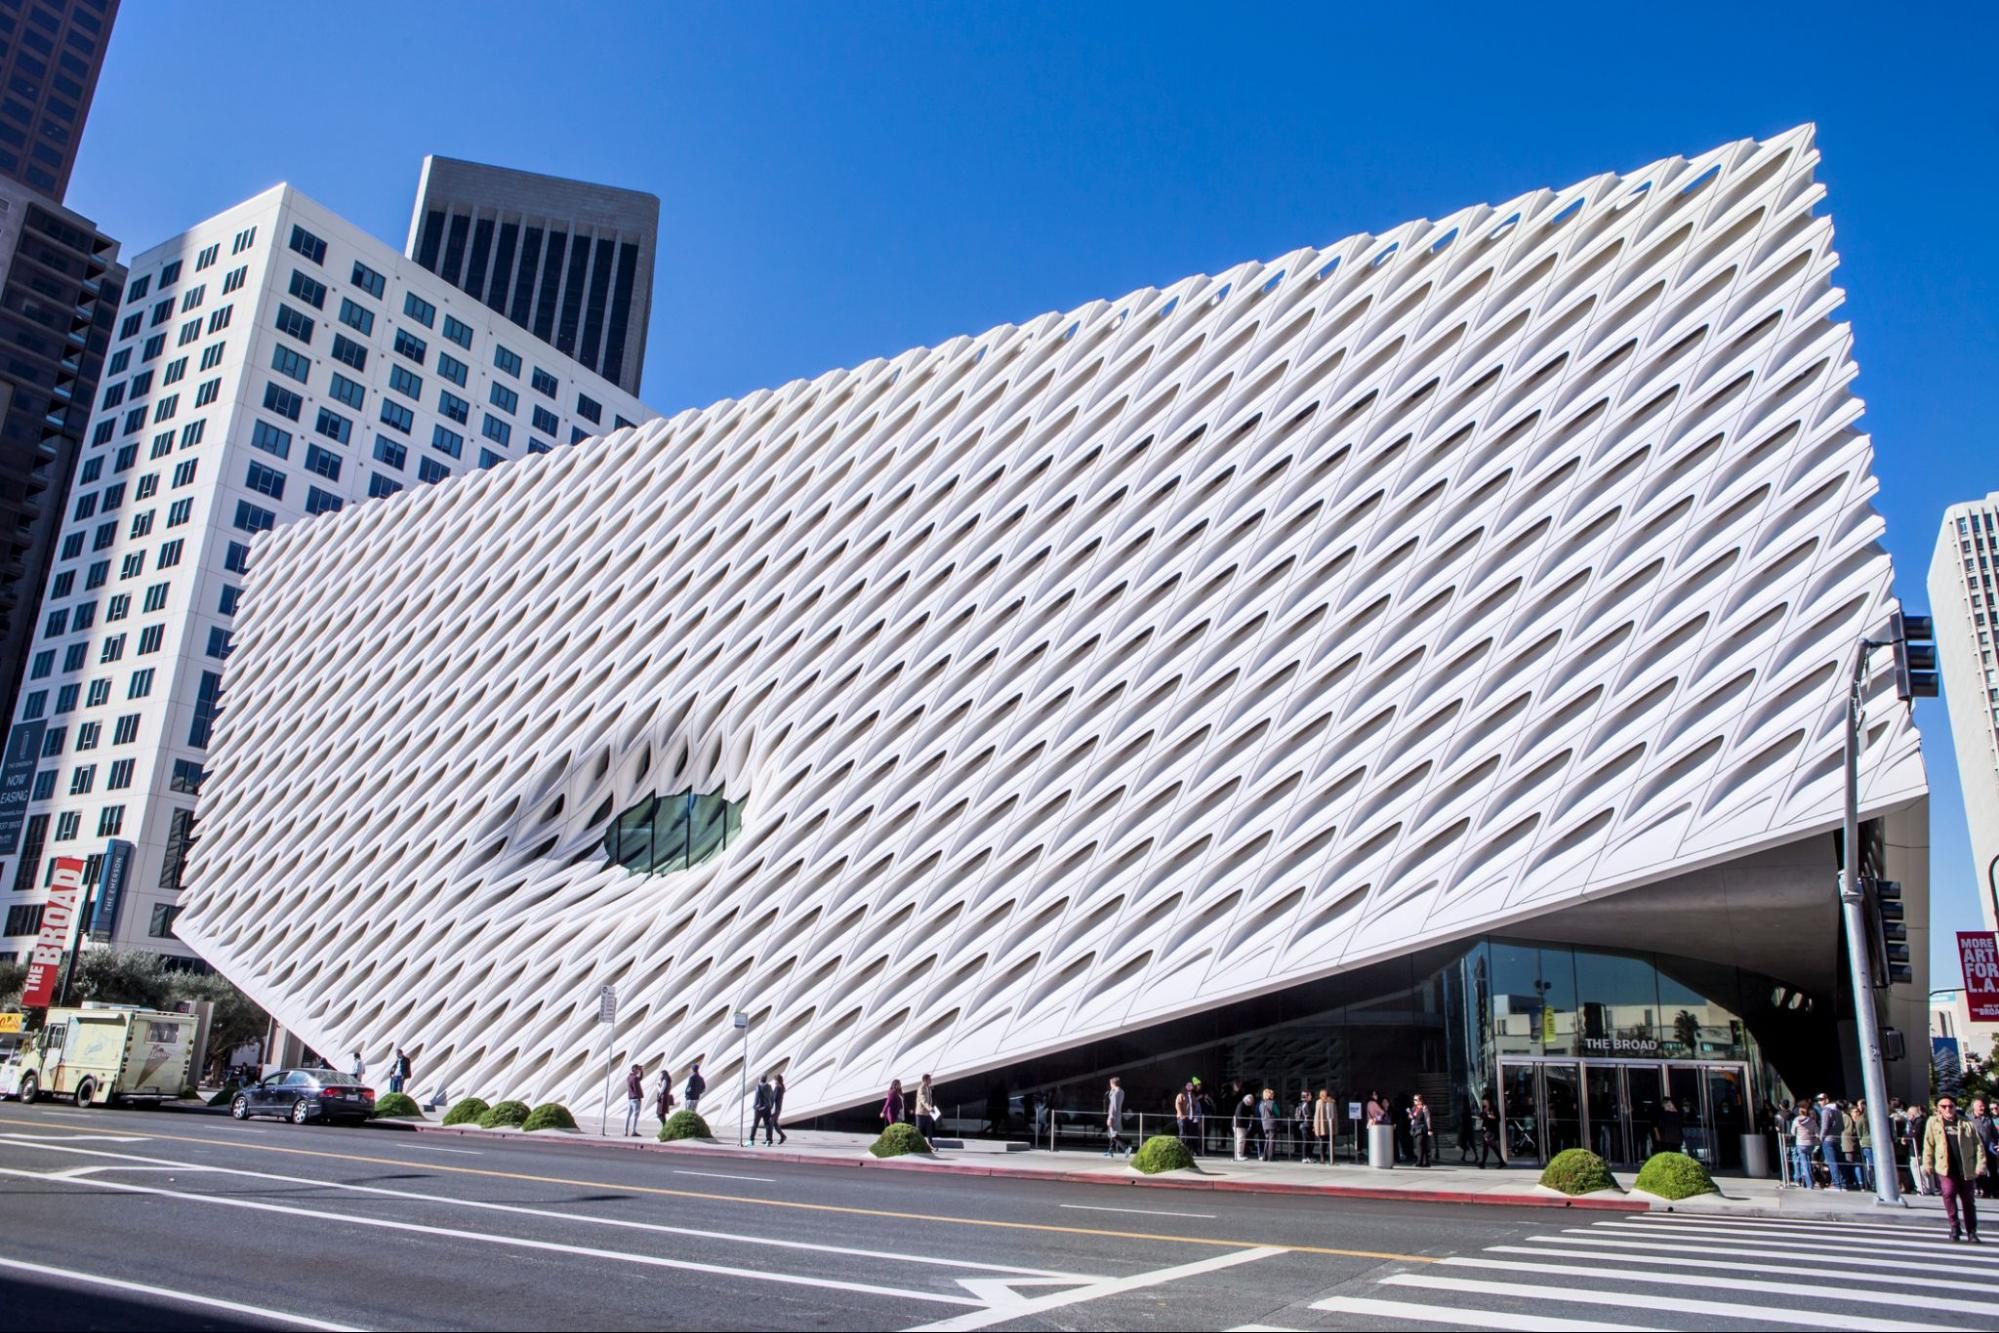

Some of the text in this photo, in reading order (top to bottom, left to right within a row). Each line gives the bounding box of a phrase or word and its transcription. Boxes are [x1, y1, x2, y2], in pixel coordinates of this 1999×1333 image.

[6, 774, 27, 787] NOW
[0, 790, 28, 804] EASING
[104, 857, 122, 912] THE EMERSON
[25, 868, 82, 992] THE BROAD
[1960, 938, 1994, 949] MORE
[1963, 948, 1995, 963] ART
[1965, 962, 1999, 978] FOR
[1966, 977, 1999, 993] L.A.
[1585, 1038, 1658, 1051] THE BROAD
